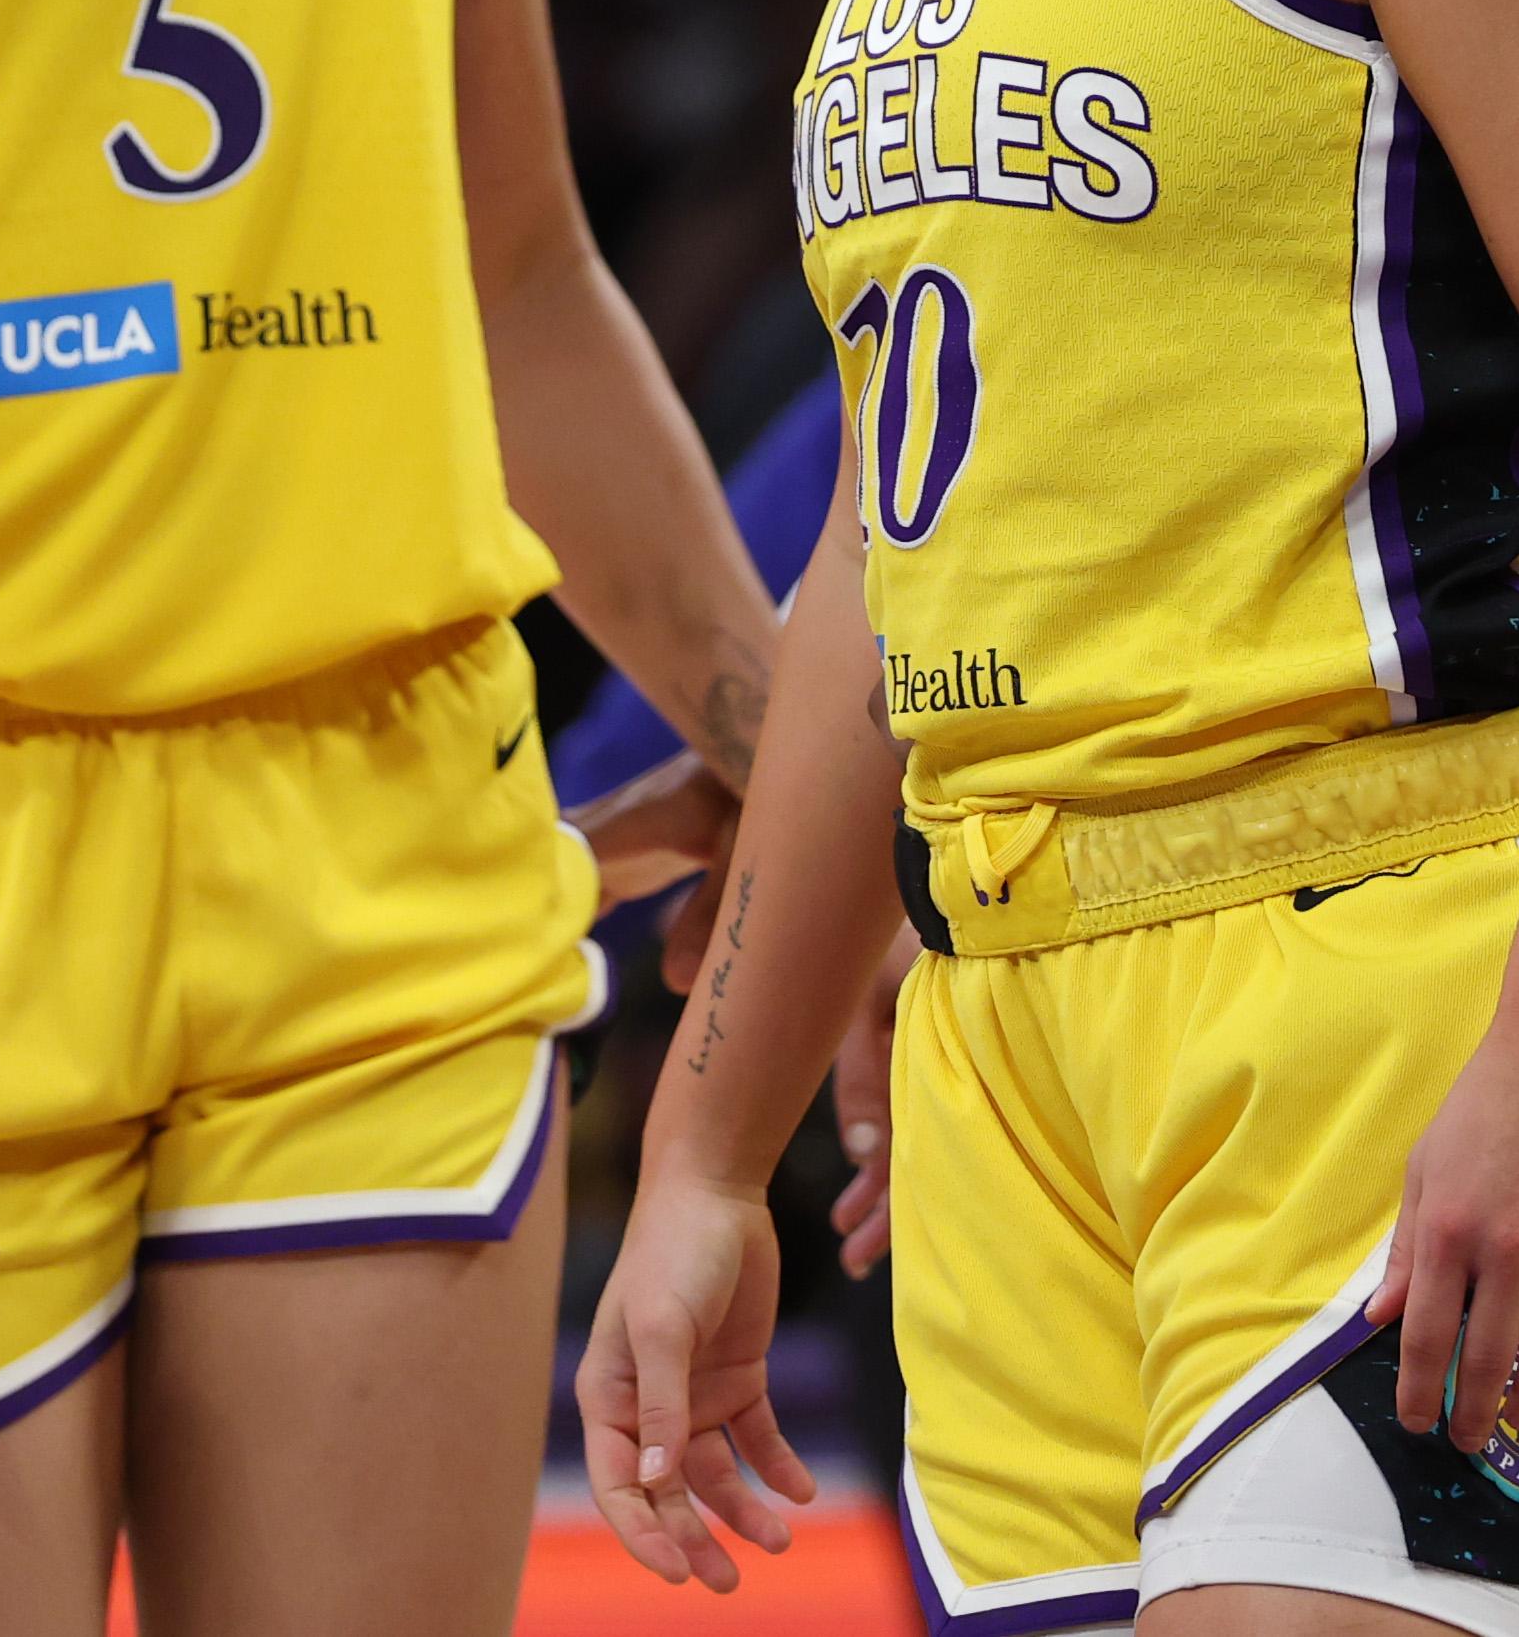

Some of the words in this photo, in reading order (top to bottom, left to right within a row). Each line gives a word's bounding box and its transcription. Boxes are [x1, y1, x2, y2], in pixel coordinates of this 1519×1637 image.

[793, 51, 1158, 244] NGELES
[0, 305, 156, 374] UCLA
[195, 288, 378, 353] Health
[888, 648, 1027, 715] Health
